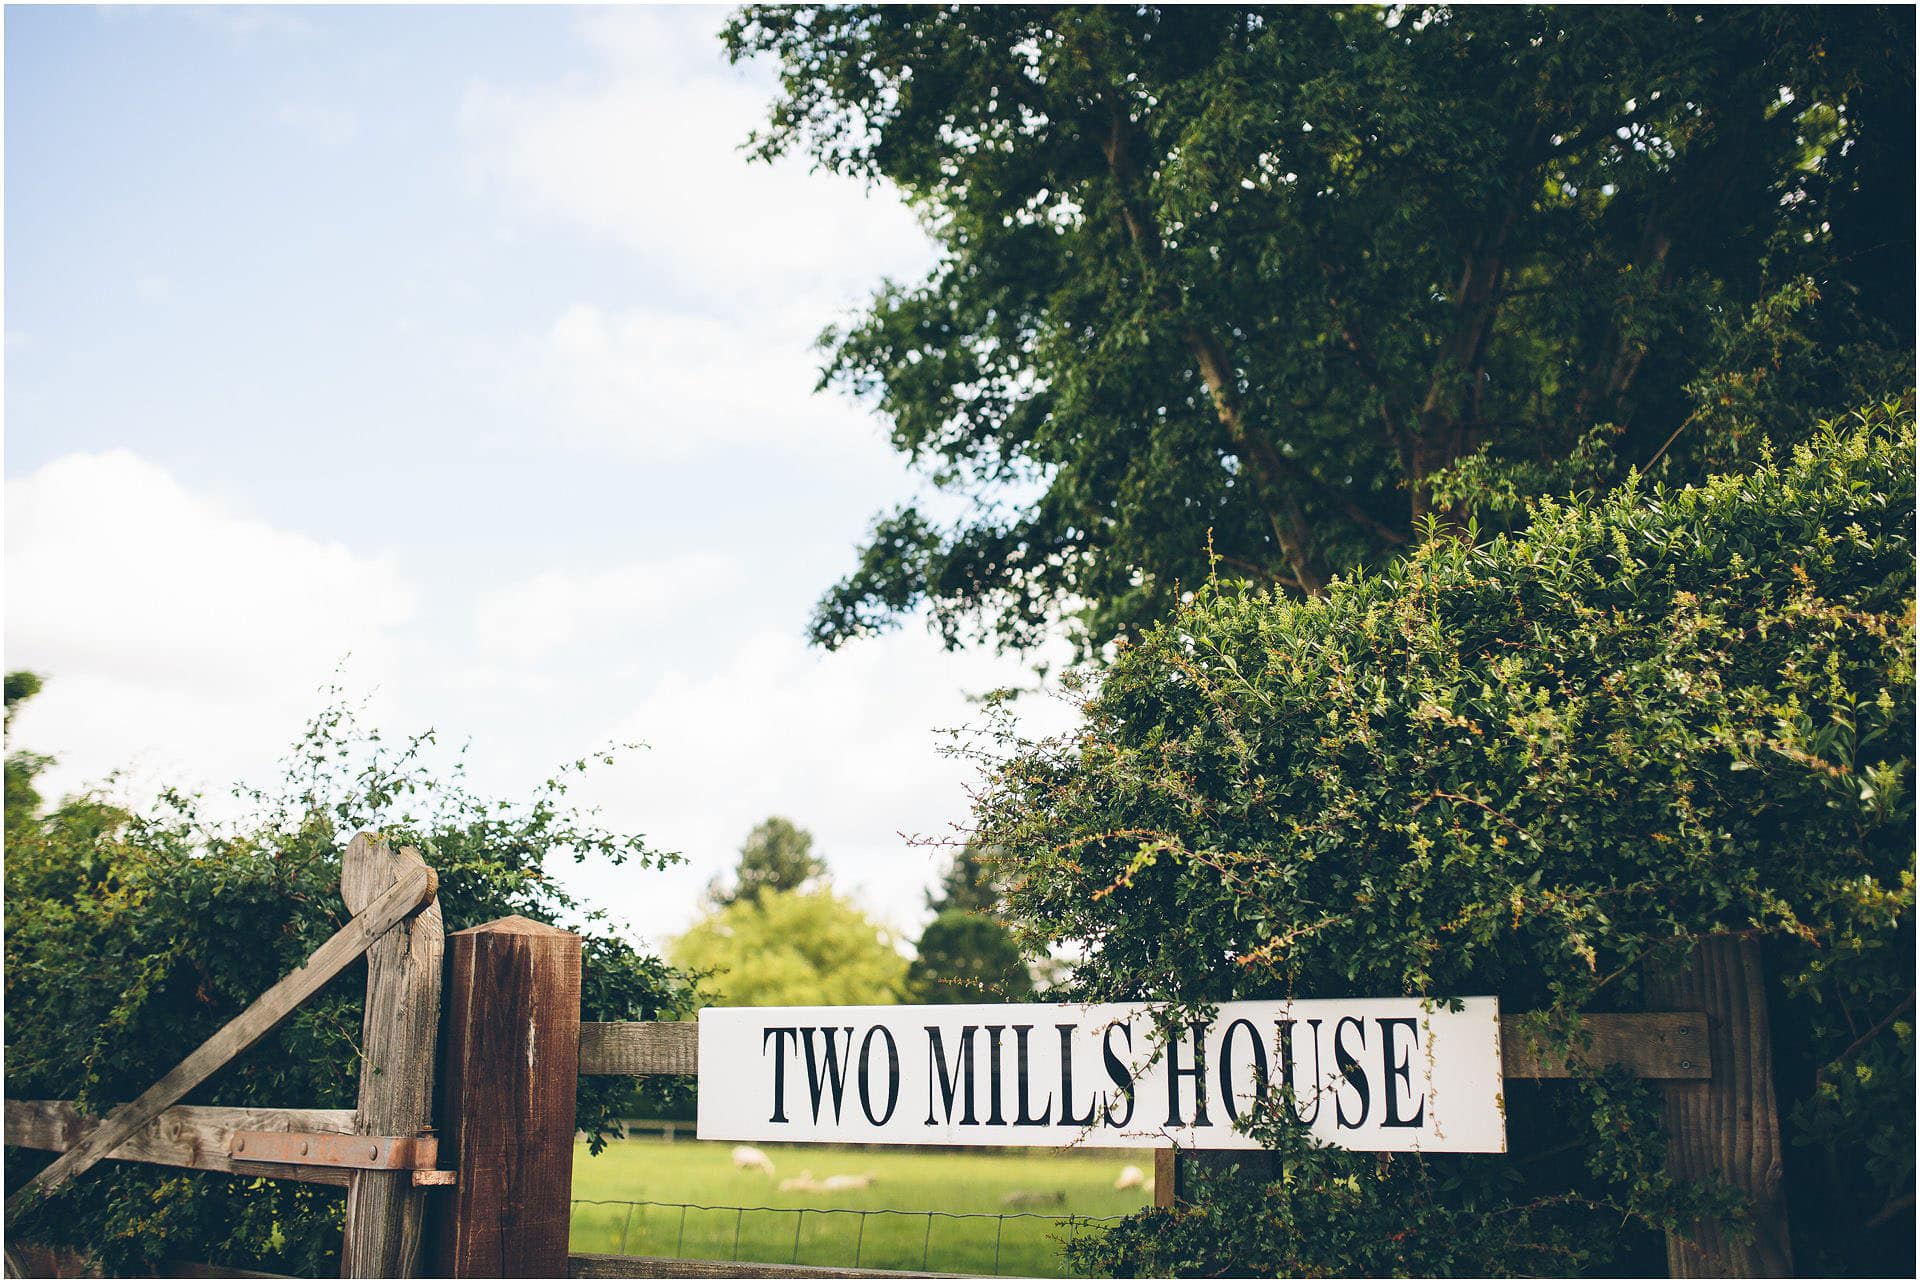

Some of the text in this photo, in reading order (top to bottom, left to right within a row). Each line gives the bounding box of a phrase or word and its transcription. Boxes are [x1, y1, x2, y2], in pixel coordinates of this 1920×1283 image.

[763, 1016, 1425, 1131] TWO MILLS HOUSE
